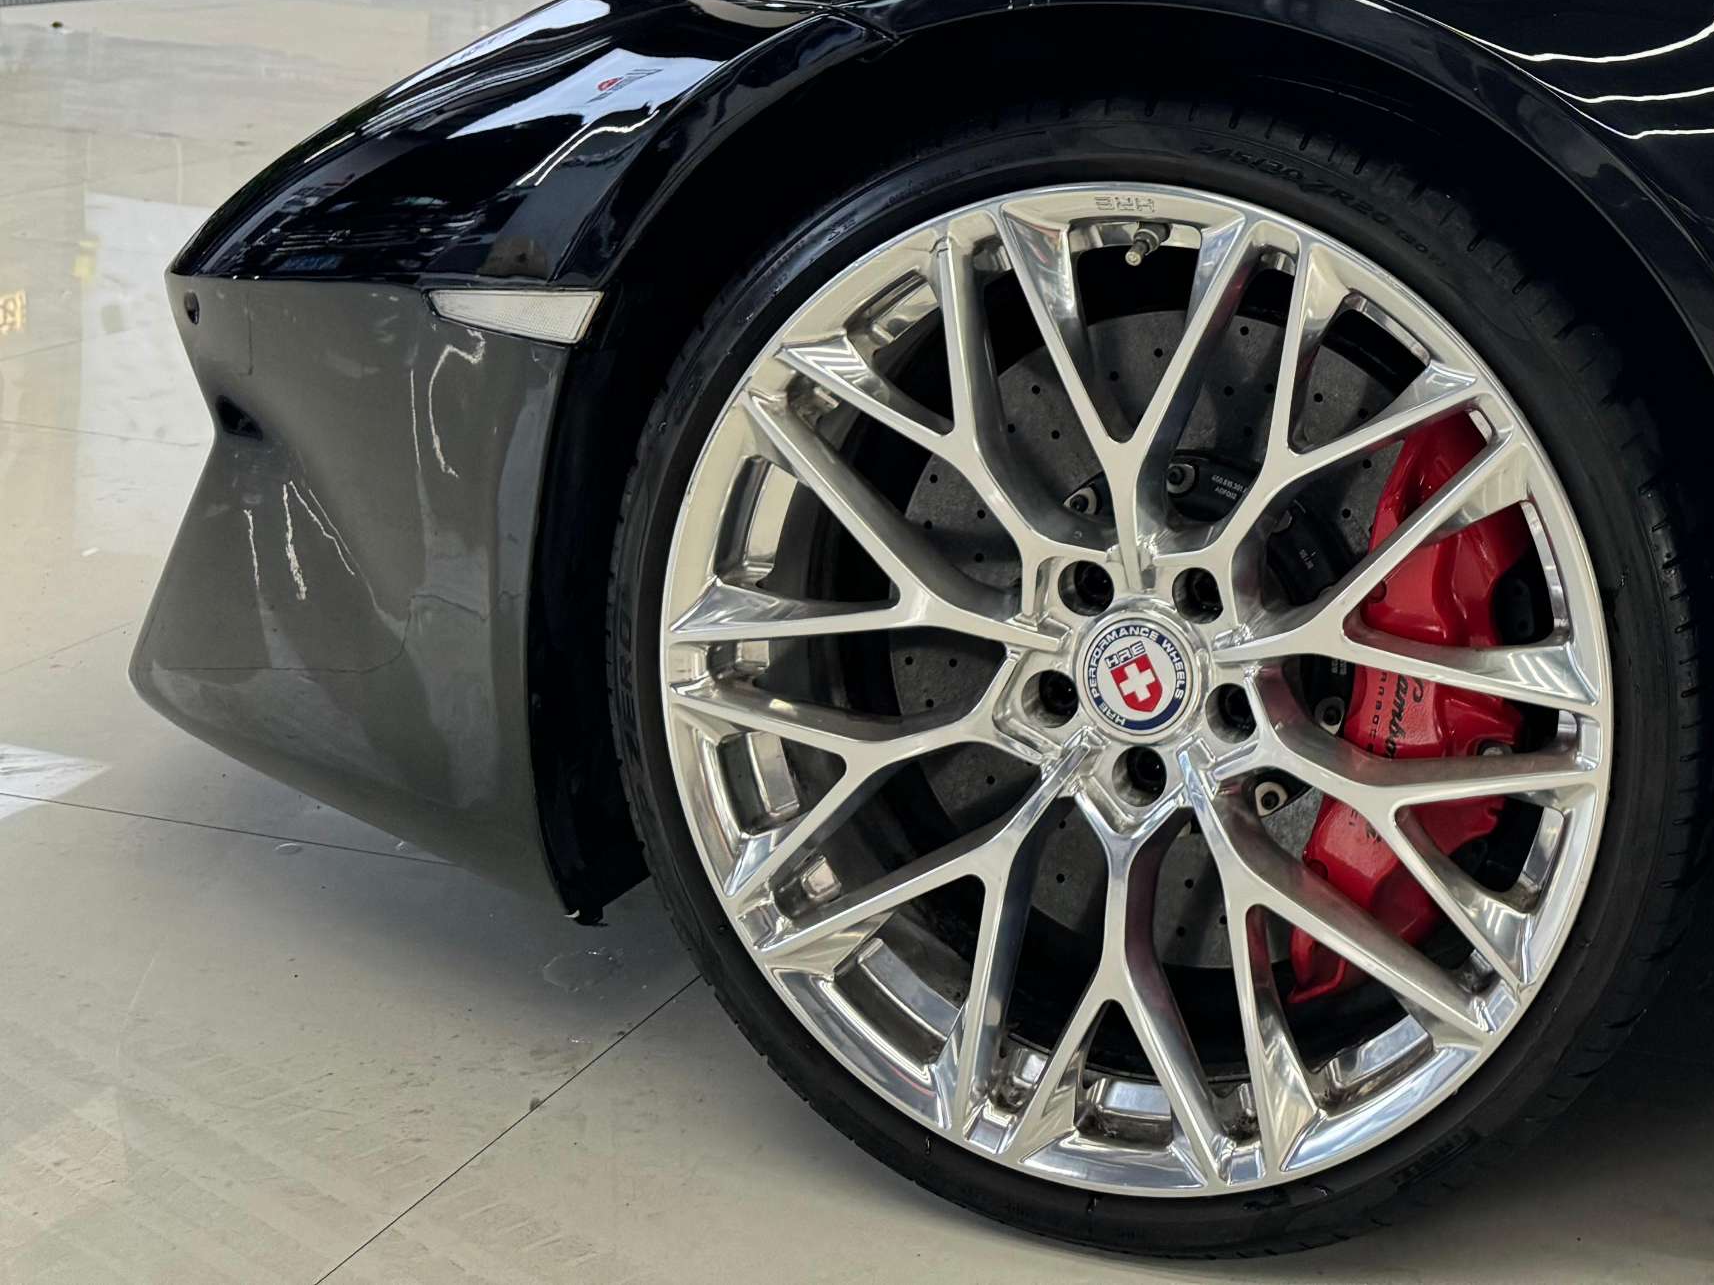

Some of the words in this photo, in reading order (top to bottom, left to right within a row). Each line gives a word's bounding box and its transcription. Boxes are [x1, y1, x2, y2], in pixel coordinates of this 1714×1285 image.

[1088, 626, 1158, 699] PERFORMANCE
[1104, 640, 1146, 669] HRE
[1161, 638, 1186, 700] WHEELS
[1098, 701, 1127, 727] HRE
